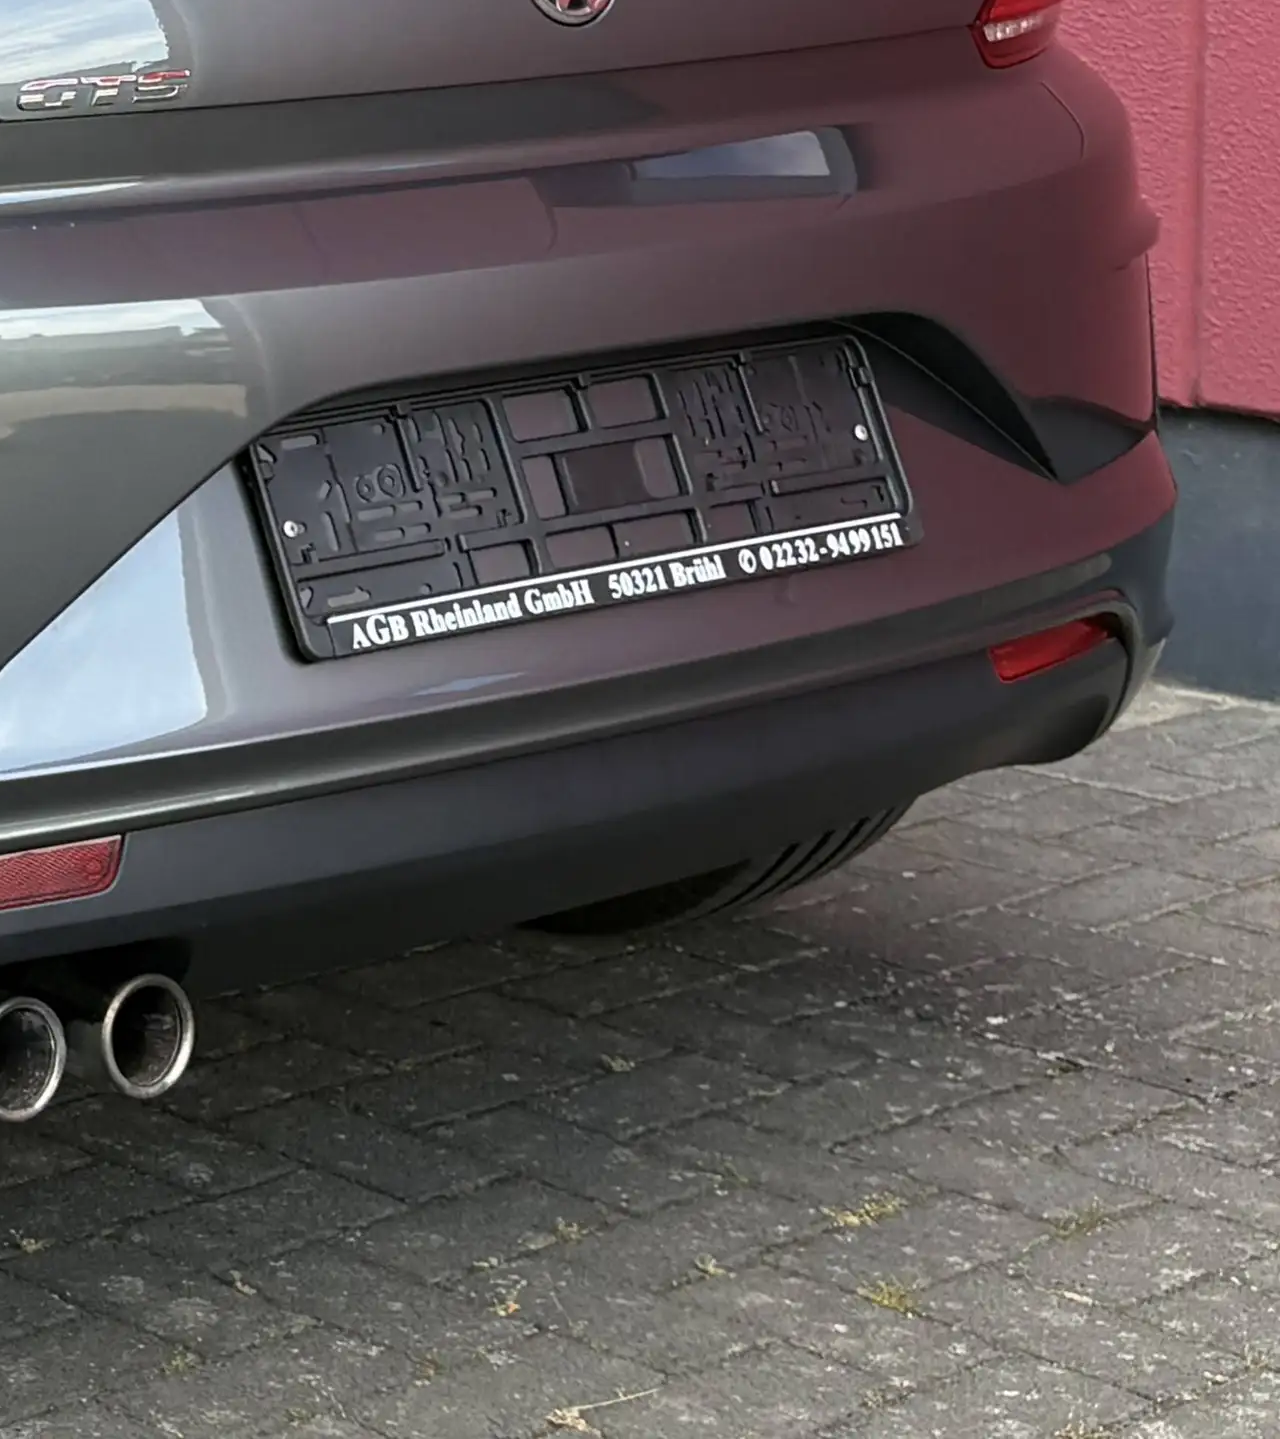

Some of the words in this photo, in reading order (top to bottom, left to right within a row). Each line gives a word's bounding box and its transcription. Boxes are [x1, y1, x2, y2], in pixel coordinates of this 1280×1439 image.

[17, 68, 191, 112] GTS
[352, 613, 409, 649] AGB
[410, 591, 523, 638] Rheinland
[524, 578, 595, 615] GmbH
[608, 565, 669, 600] 50321
[669, 553, 726, 588] Brühl
